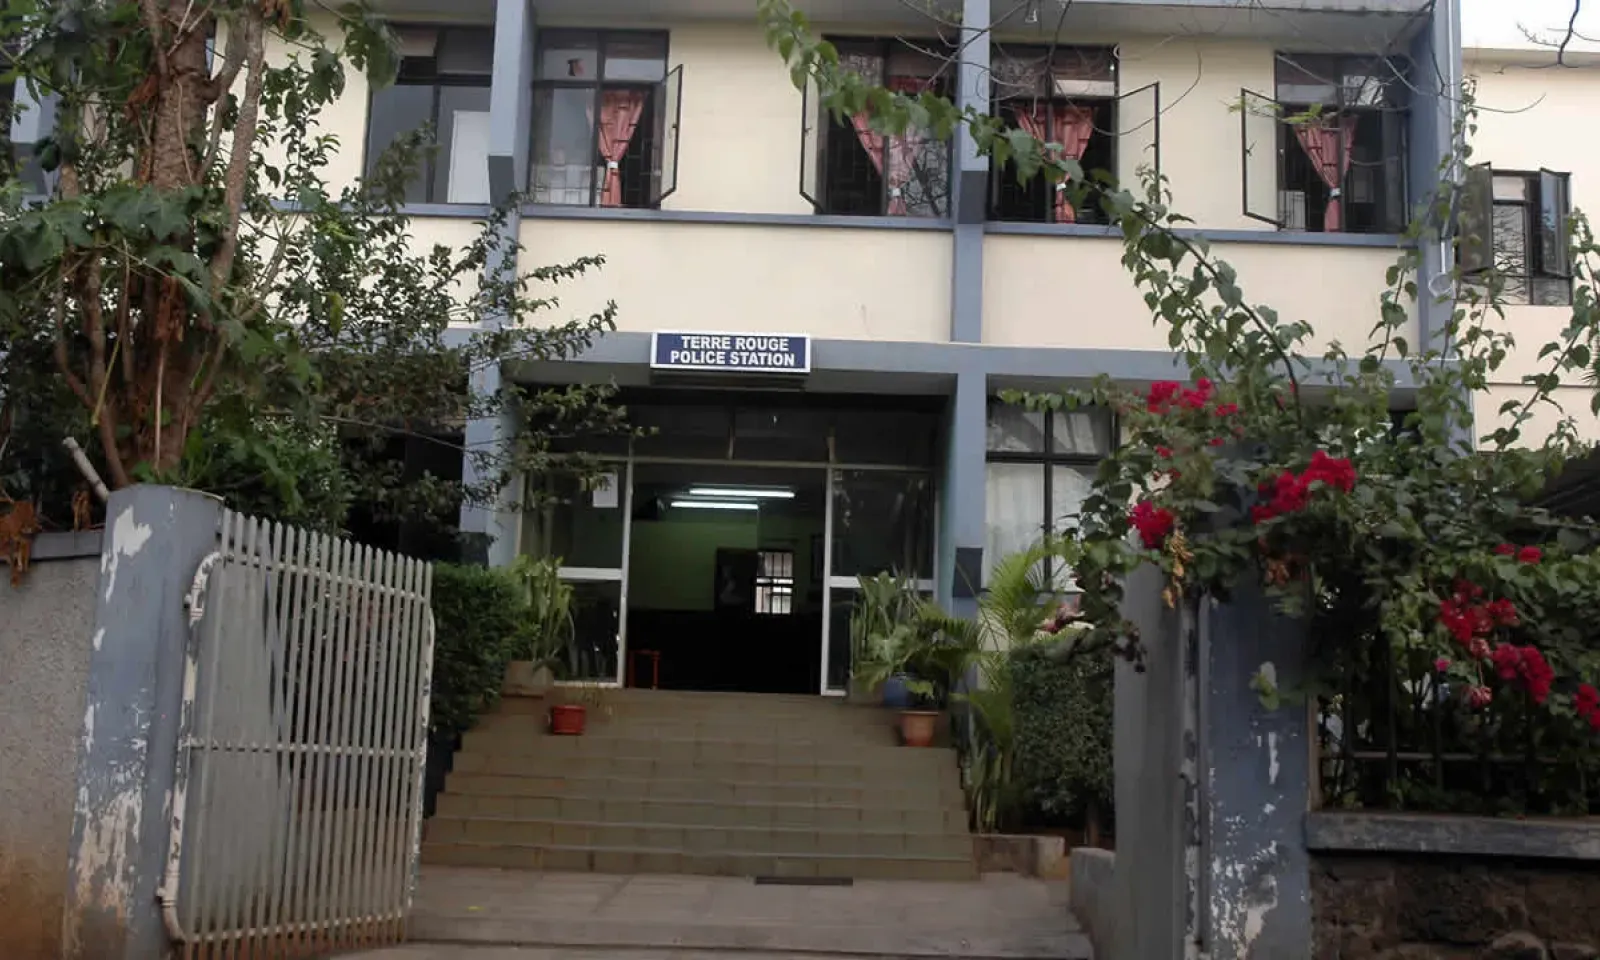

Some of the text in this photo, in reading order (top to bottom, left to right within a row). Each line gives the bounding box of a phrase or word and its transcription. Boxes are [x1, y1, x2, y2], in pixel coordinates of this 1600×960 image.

[681, 336, 789, 351] TERRE ROUGE
[670, 350, 795, 366] POLICE STATION
